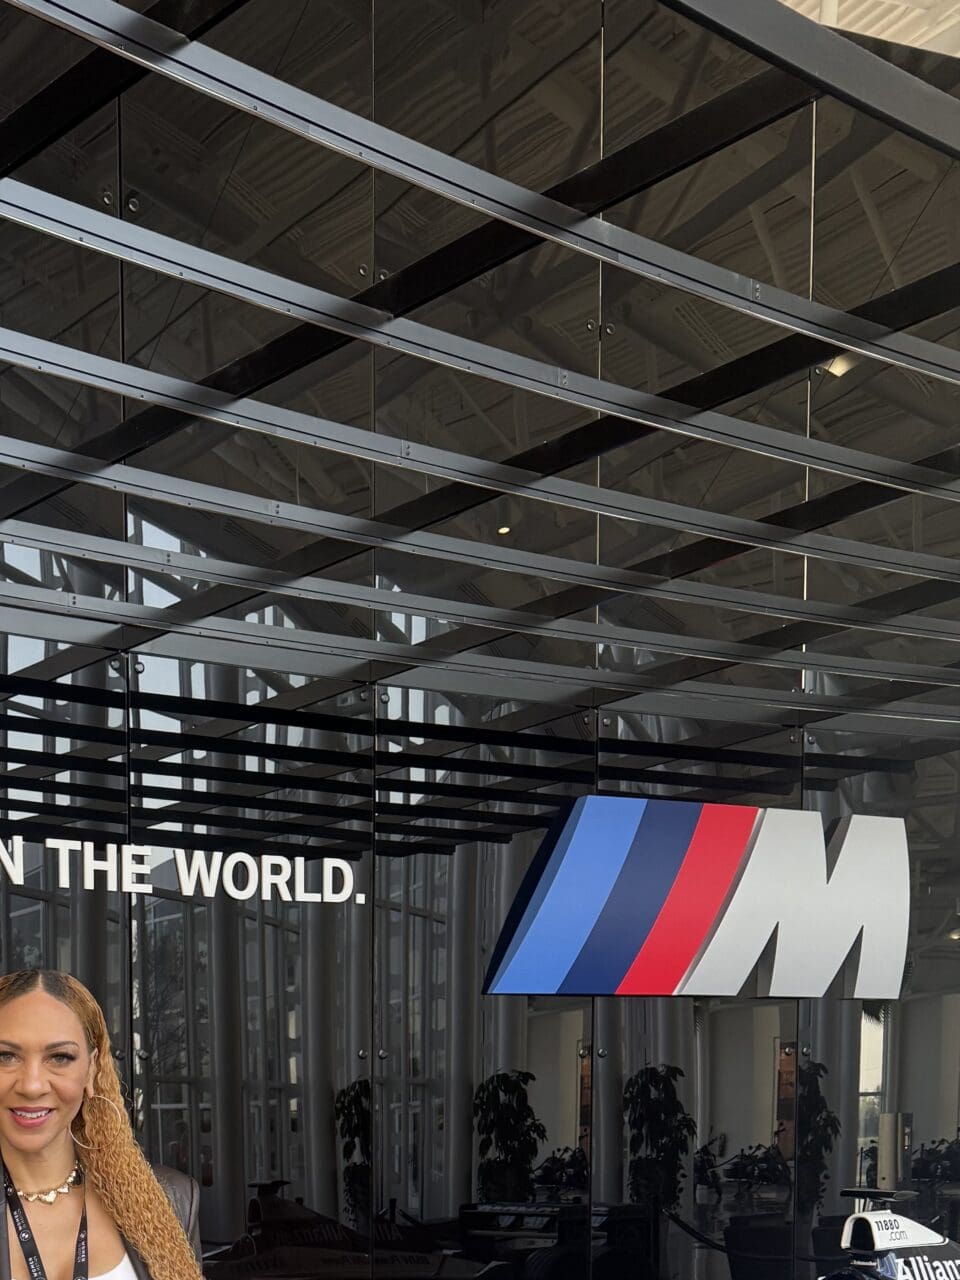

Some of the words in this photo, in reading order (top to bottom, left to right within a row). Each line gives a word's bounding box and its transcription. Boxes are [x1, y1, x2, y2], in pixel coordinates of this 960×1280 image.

[45, 838, 153, 894] THE
[173, 849, 366, 905] WORLD.
[676, 800, 910, 1000] M
[875, 1219, 900, 1232] 11880
